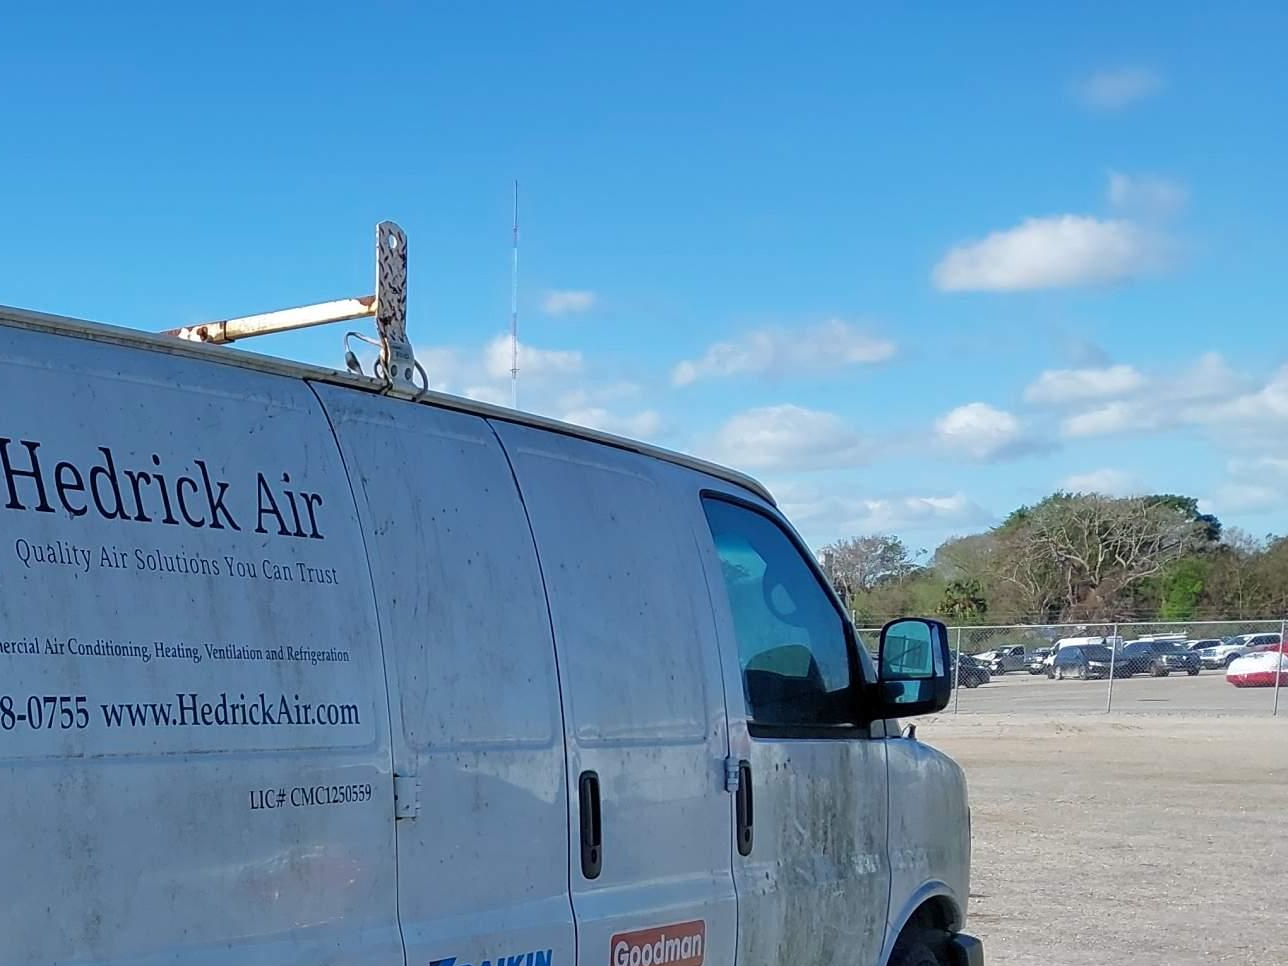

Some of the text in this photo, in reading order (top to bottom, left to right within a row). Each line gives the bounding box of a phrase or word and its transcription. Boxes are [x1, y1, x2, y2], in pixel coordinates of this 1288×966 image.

[255, 472, 324, 540] Air
[15, 538, 339, 585] Quality Air Solutions You Can Trust
[44, 638, 65, 655] Air
[67, 638, 152, 663] Conditioning,
[154, 641, 202, 663] Heating,
[204, 643, 263, 661] Ventilation
[266, 646, 284, 661] and
[287, 646, 349, 666] Refrigeration
[100, 693, 360, 728] www.HedrickAir.com
[249, 784, 372, 811] LIC# CMC1250559
